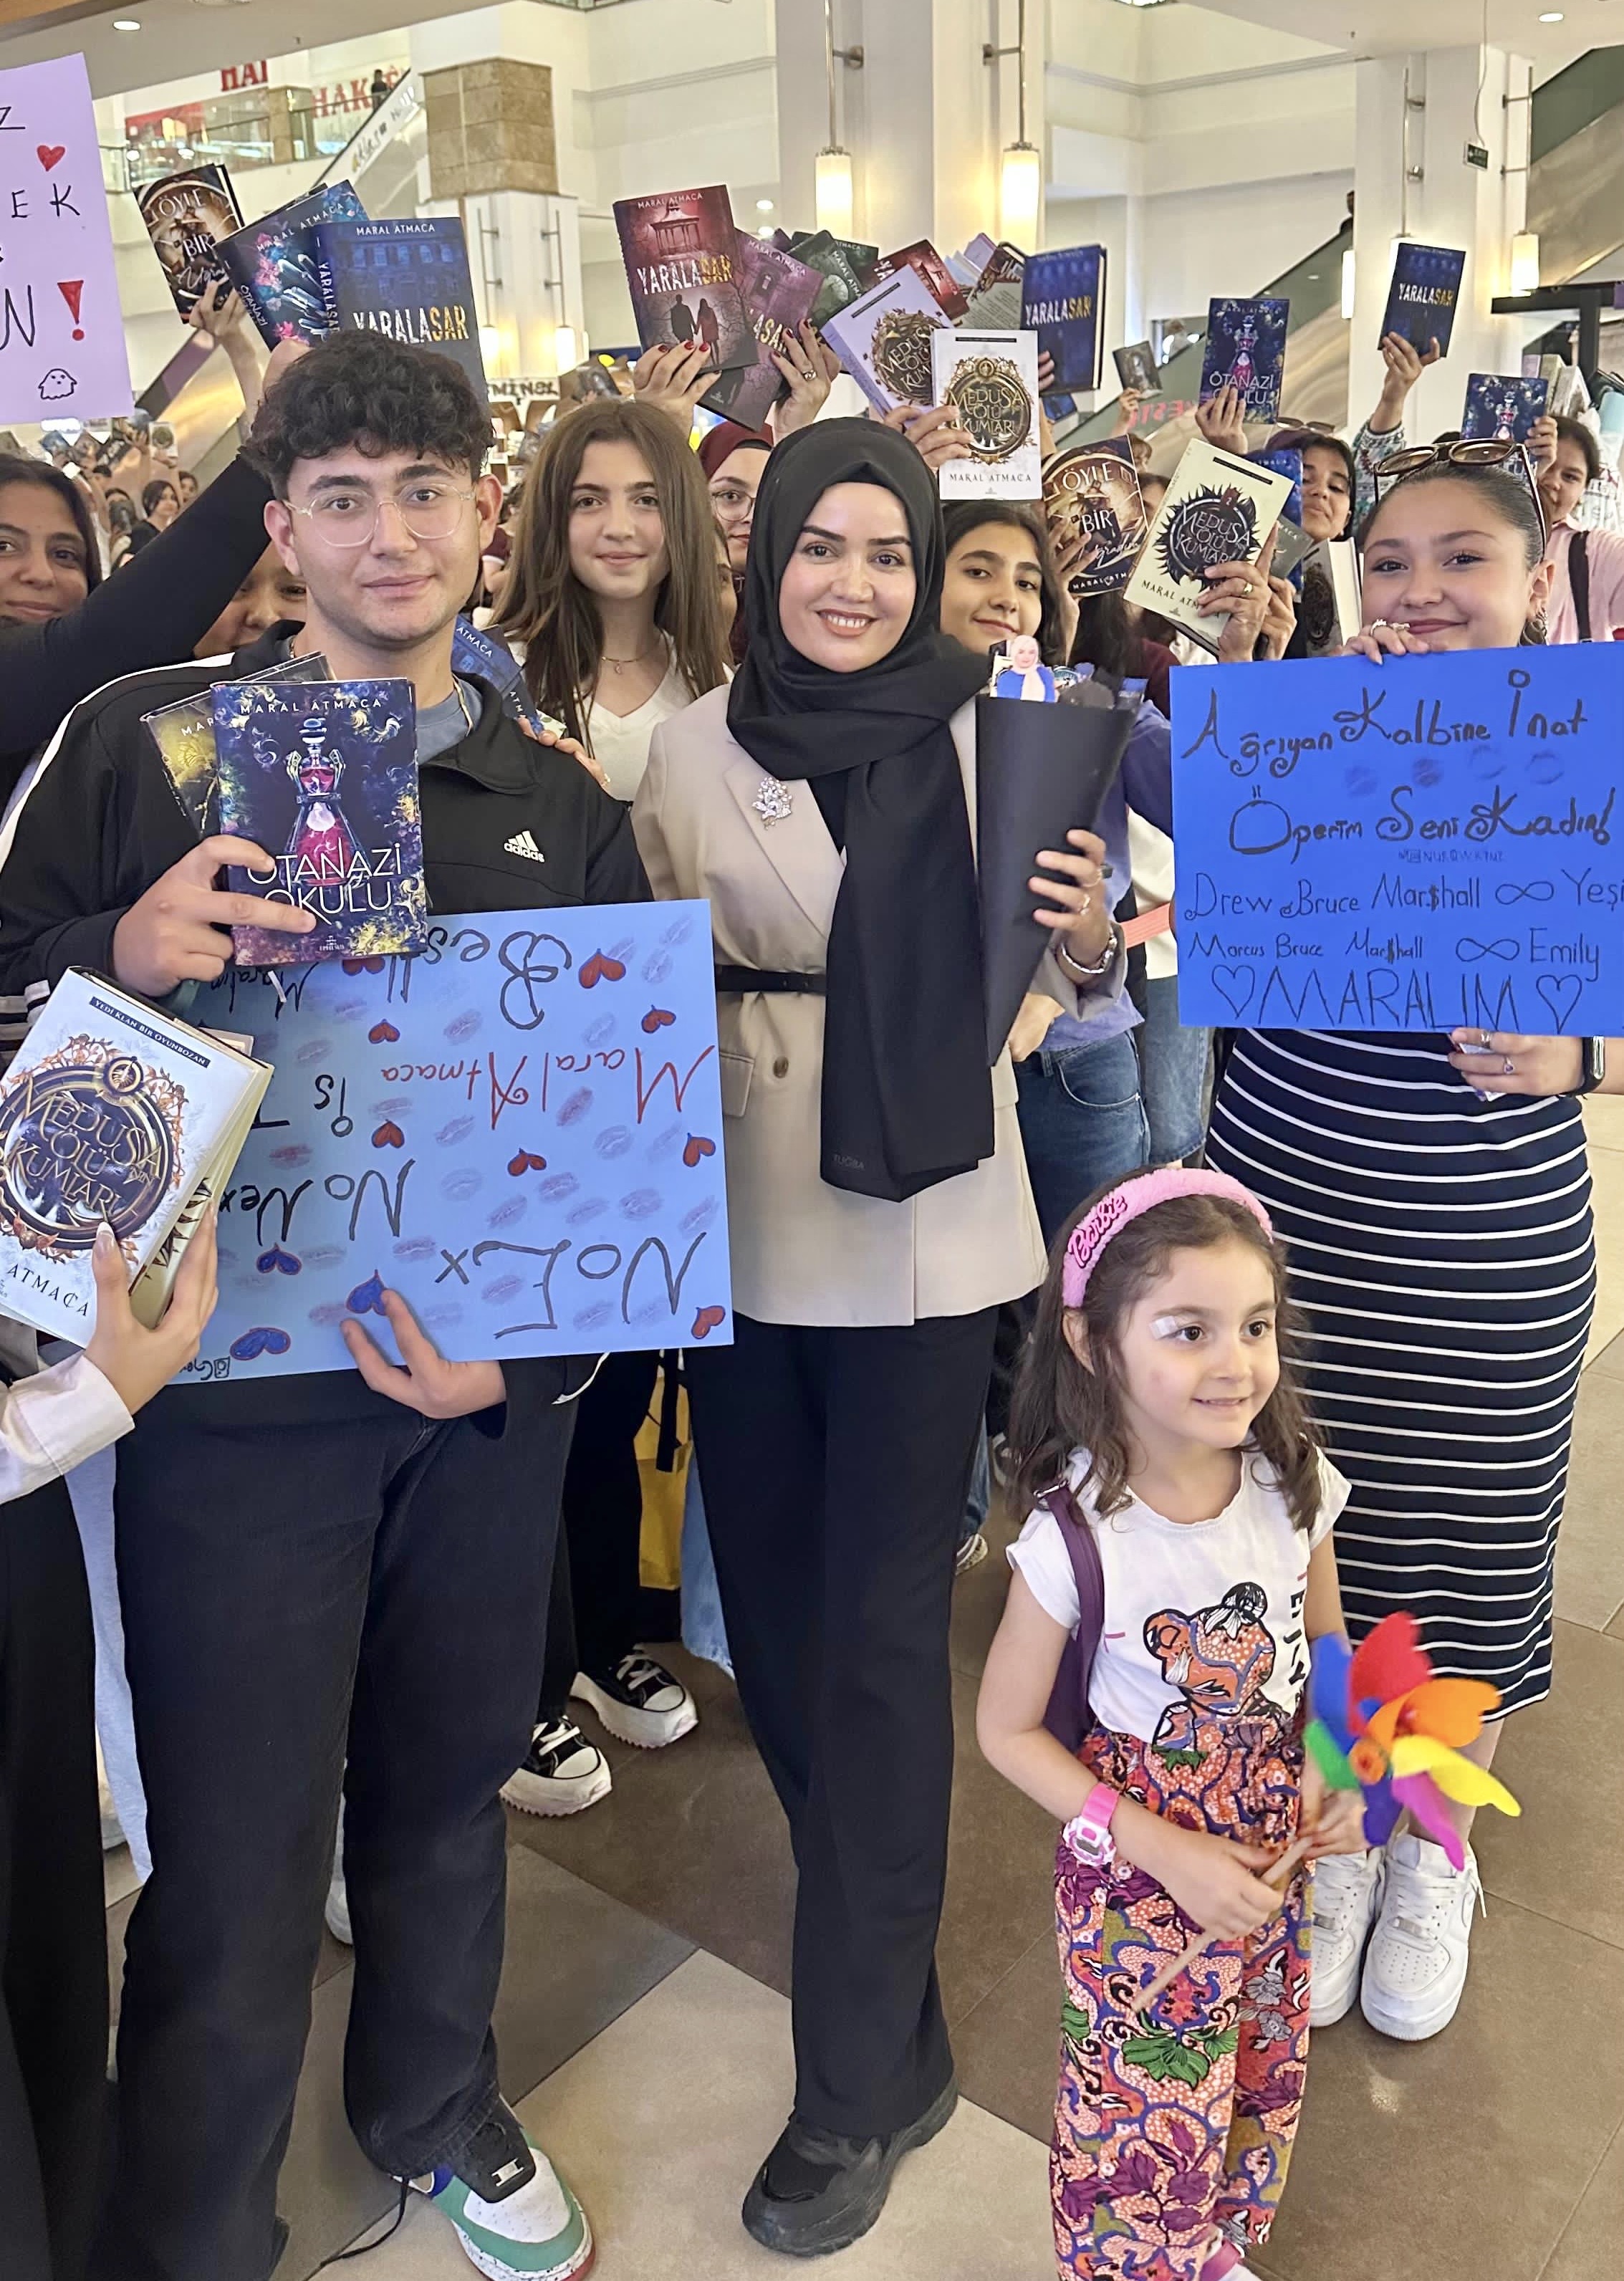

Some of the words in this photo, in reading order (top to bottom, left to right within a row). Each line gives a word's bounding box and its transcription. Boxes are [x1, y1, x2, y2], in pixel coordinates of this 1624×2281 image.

[356, 225, 390, 237] MARAL
[394, 223, 436, 234] ATMACA
[637, 254, 734, 295] YARALASAR
[1399, 282, 1454, 307] YARALASAR
[353, 304, 470, 345] YARALASAR
[1025, 294, 1092, 327] YARALASAR
[949, 473, 984, 484] MARAL
[989, 473, 1032, 483] ATMACA
[1081, 508, 1113, 533] BİR
[1176, 502, 1251, 547] MEDUSA
[1141, 579, 1176, 600] MARAL
[456, 625, 494, 658] ATMACA
[241, 703, 299, 715] MARAL
[311, 698, 382, 711] ATMACA
[1375, 784, 1460, 842] Seni
[504, 842, 545, 863] adidas
[1183, 871, 1273, 921] Drew
[1279, 878, 1361, 919] Bruce
[1275, 933, 1325, 959] Bruce
[1529, 927, 1600, 982] Emily
[93, 999, 115, 1017] YEDİ
[115, 1009, 138, 1029] KLAN
[138, 1022, 154, 1038] BİR
[153, 1029, 206, 1066] OYUNBOZAN
[380, 1050, 529, 1130] Atmaca
[541, 1045, 715, 1124] Maral
[5, 1077, 163, 1179] MEDUSA
[49, 1128, 111, 1183] ÖLÜ
[325, 1158, 416, 1242] No
[1067, 1196, 1128, 1269] Barbie
[7, 1263, 89, 1317] ATMACA
[433, 1238, 573, 1340] Ex
[577, 1231, 707, 1325] No
